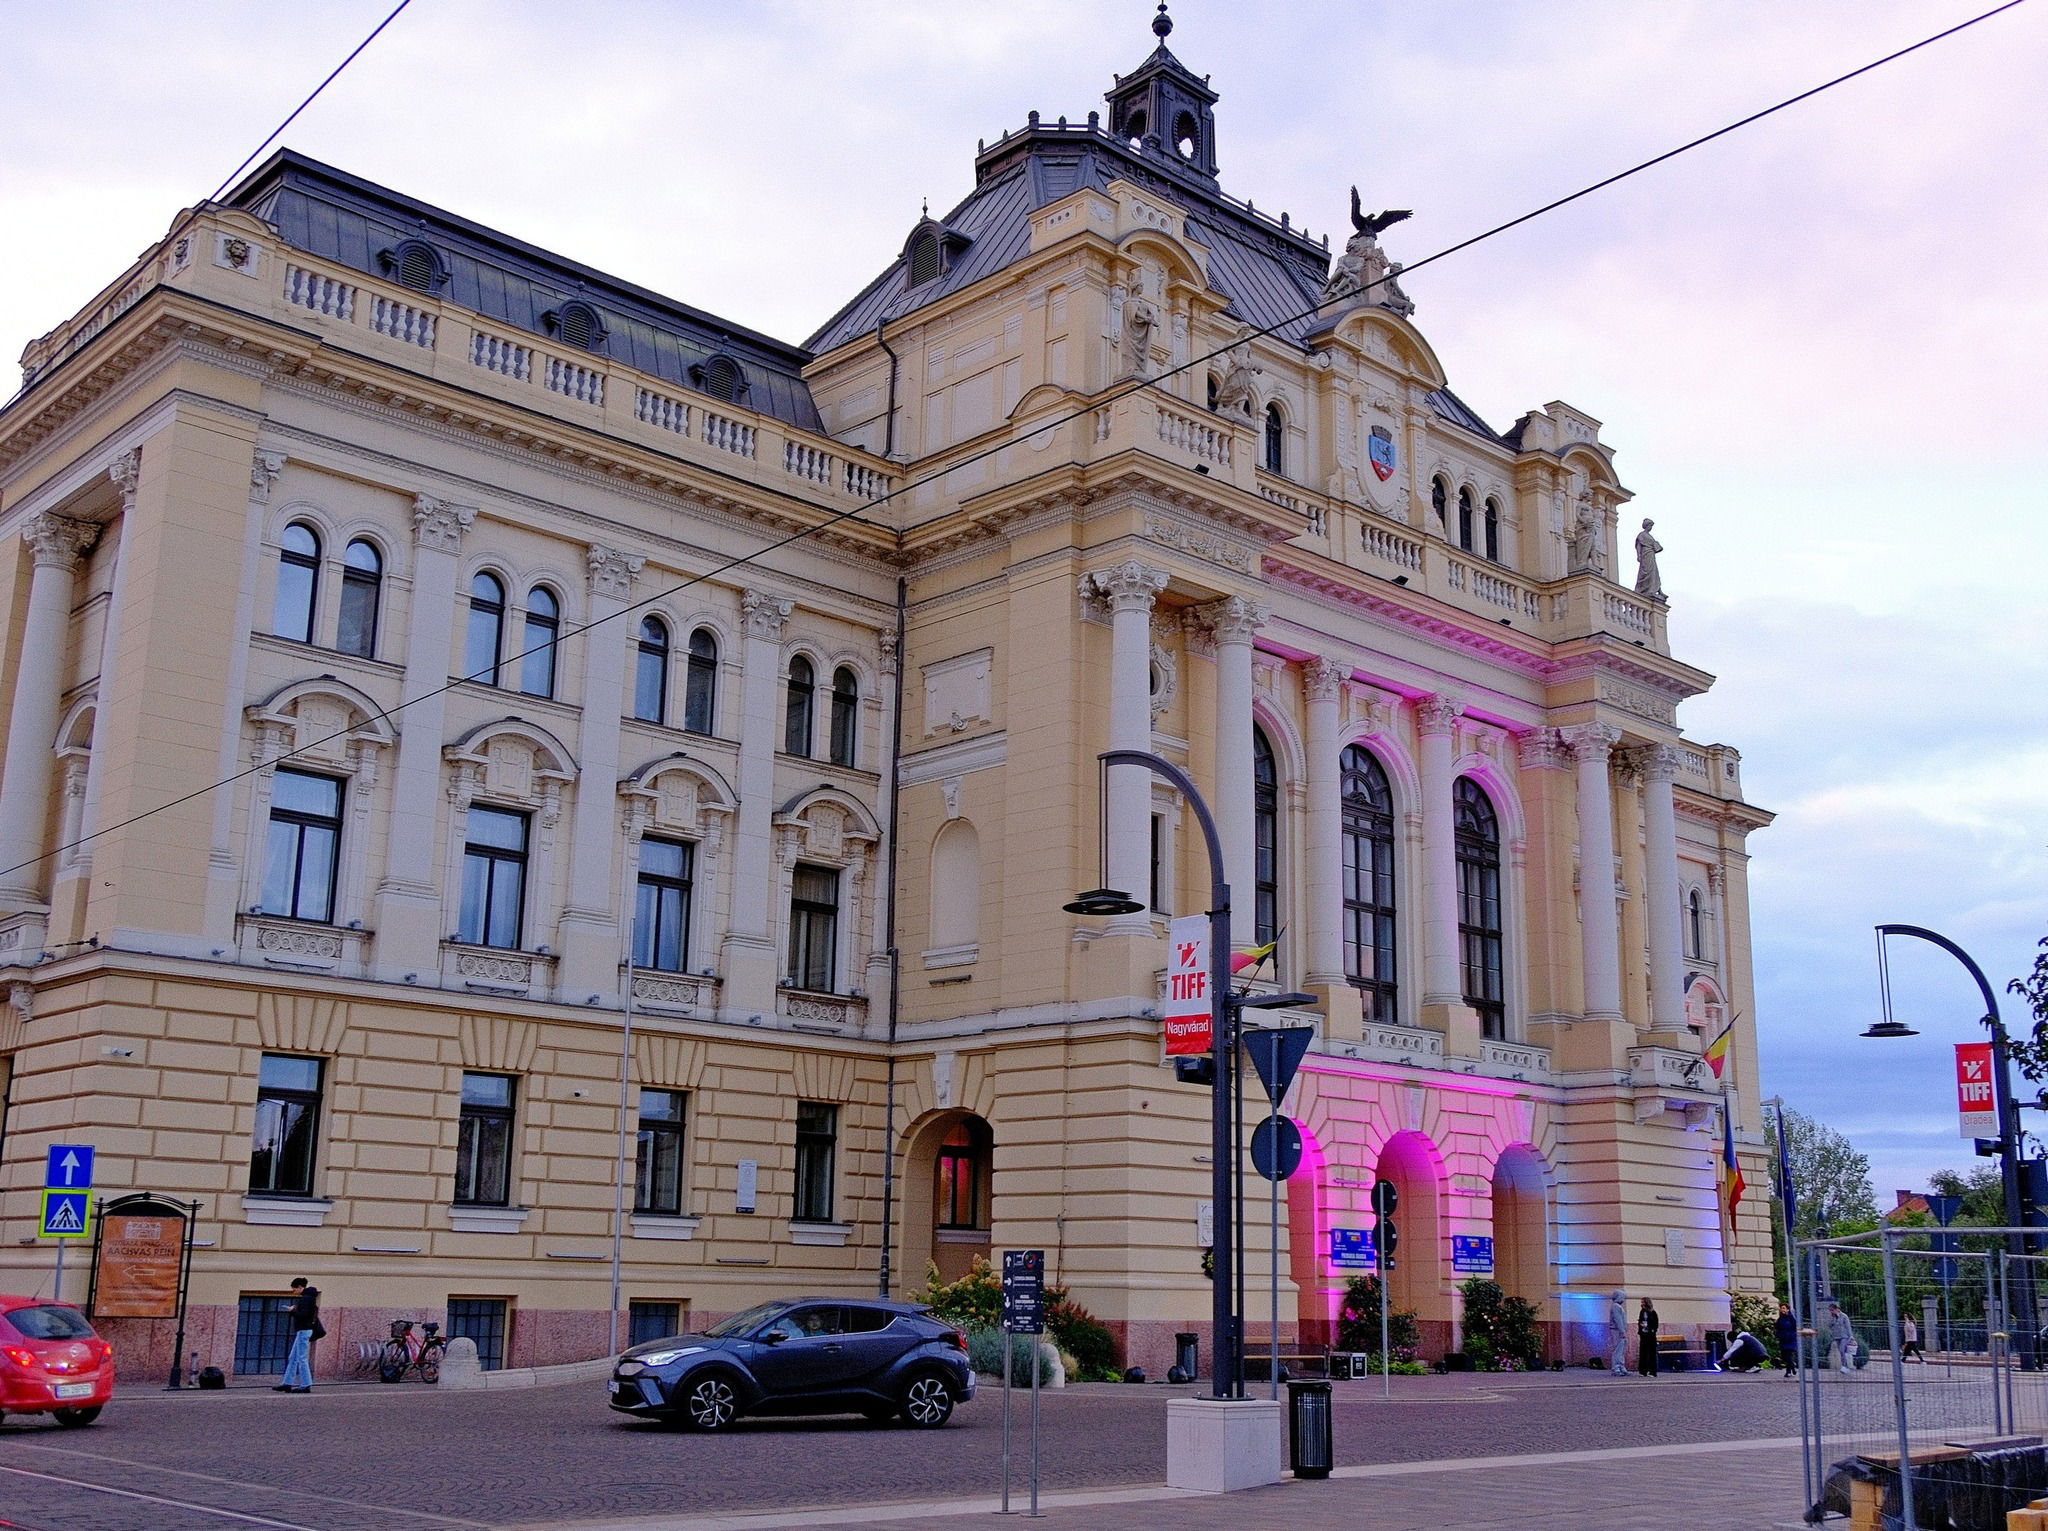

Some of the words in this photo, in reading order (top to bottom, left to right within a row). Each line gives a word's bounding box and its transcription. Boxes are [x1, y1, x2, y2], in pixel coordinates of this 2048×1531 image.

[1171, 971, 1206, 1001] TIFF
[1167, 1019, 1209, 1036] Nagyvárad
[1959, 1081, 1990, 1102] TIFF
[1963, 1114, 1993, 1126] Oradea
